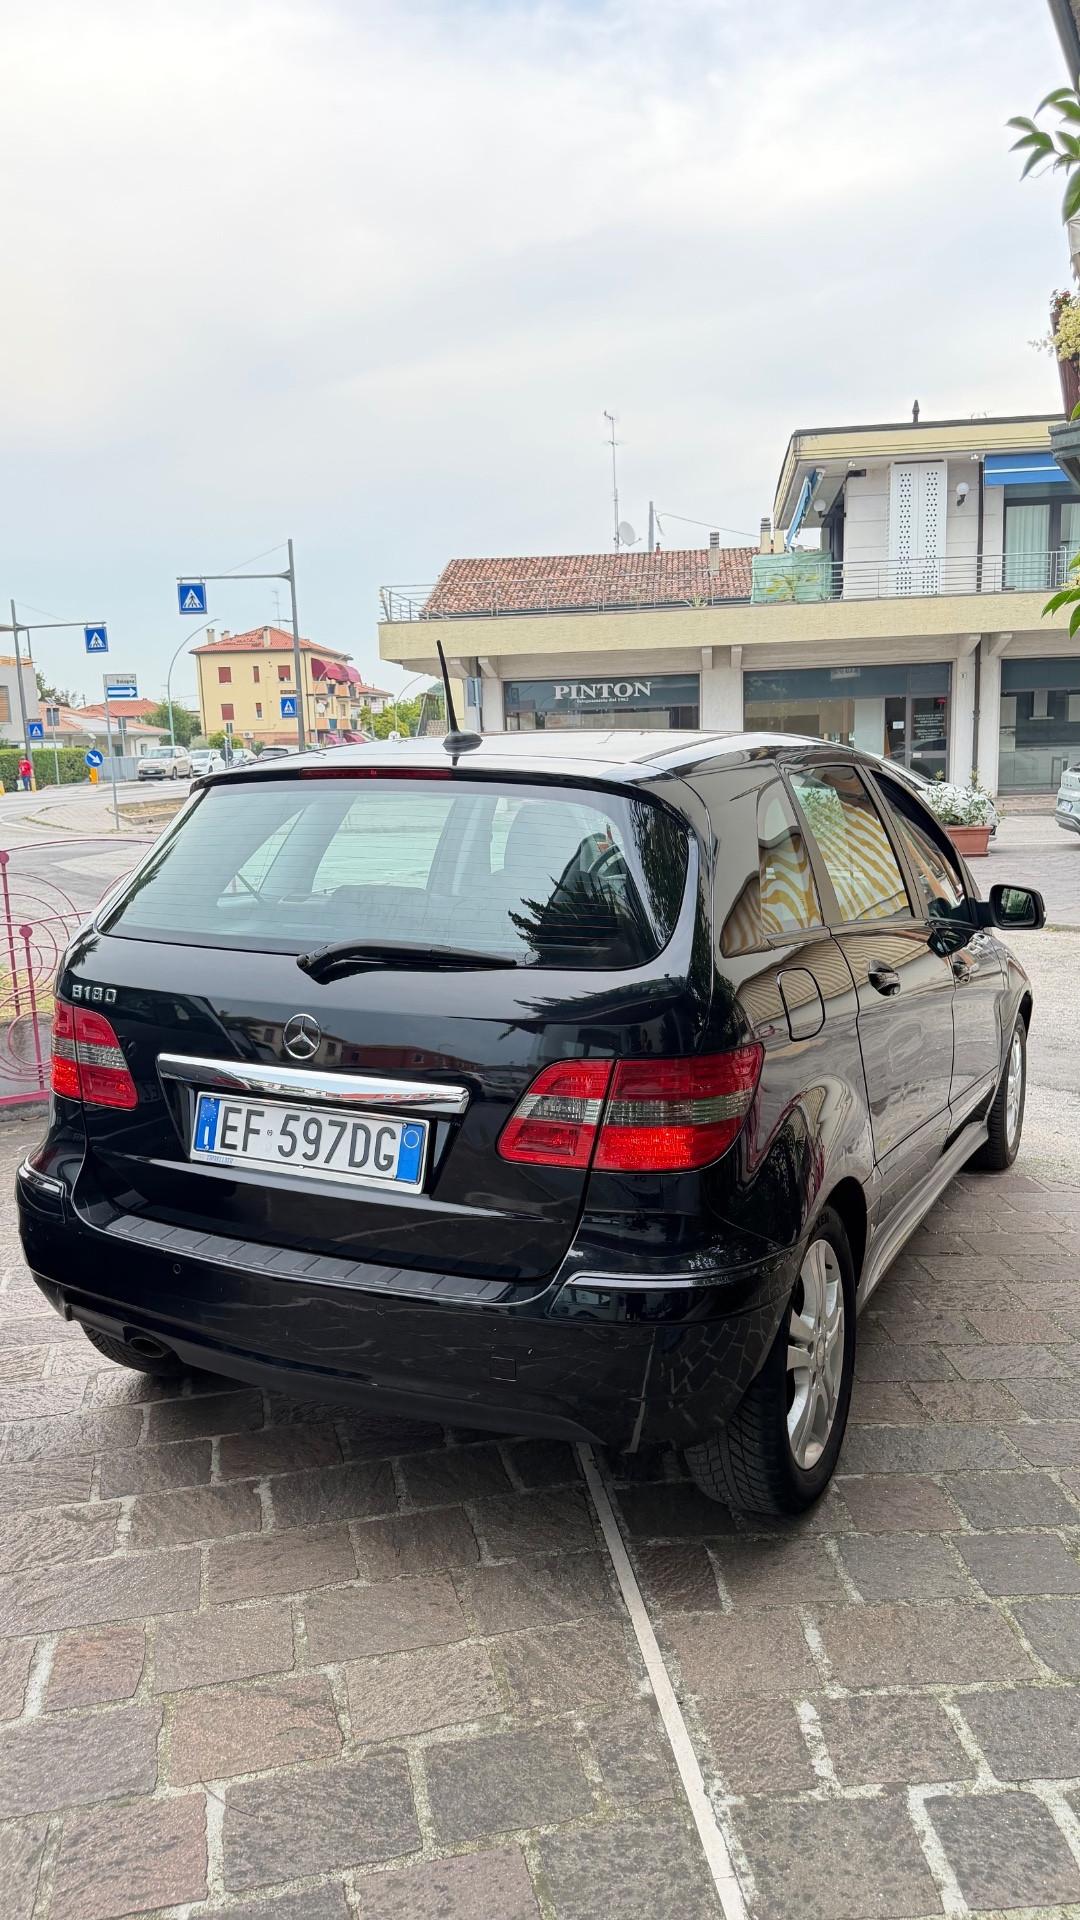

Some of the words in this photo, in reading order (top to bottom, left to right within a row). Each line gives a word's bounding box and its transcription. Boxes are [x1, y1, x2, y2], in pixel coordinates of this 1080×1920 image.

[552, 681, 652, 700] PINTON
[72, 984, 117, 1003] B180
[219, 1106, 265, 1152] EF
[277, 1113, 397, 1172] 597DG
